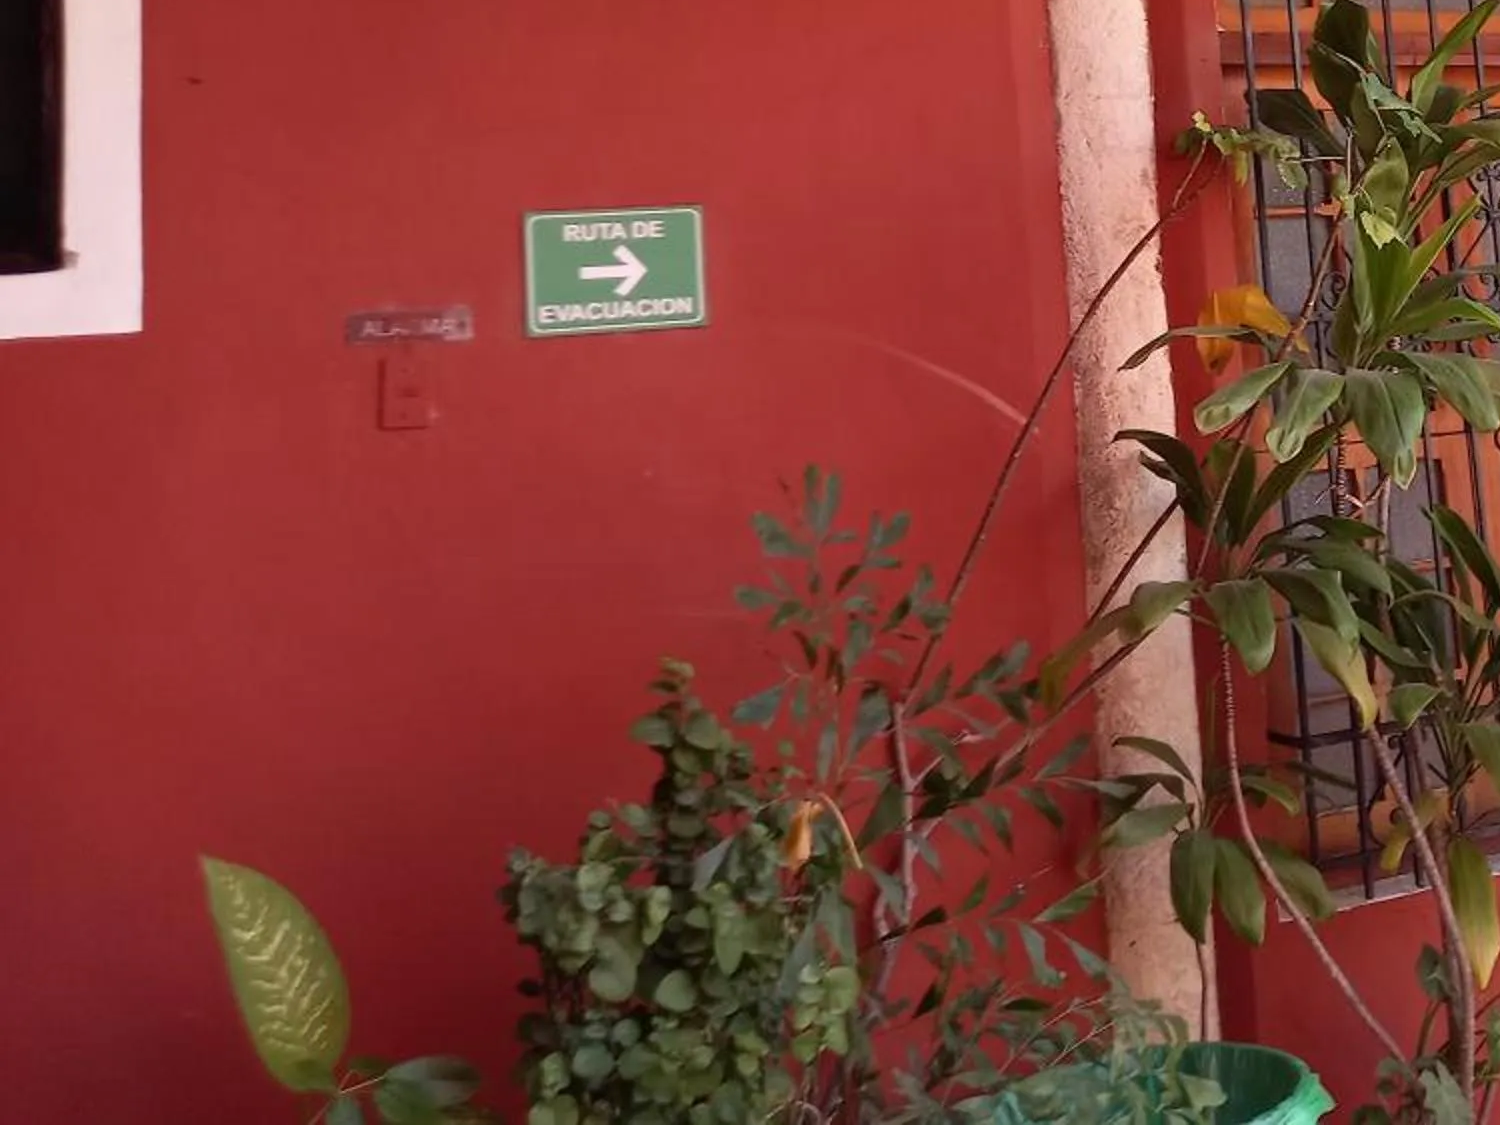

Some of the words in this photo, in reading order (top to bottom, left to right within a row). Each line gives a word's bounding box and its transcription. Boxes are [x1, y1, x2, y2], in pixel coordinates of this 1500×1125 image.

[562, 222, 627, 242] RUTA
[632, 220, 666, 238] DE
[538, 297, 694, 324] EVACUACION
